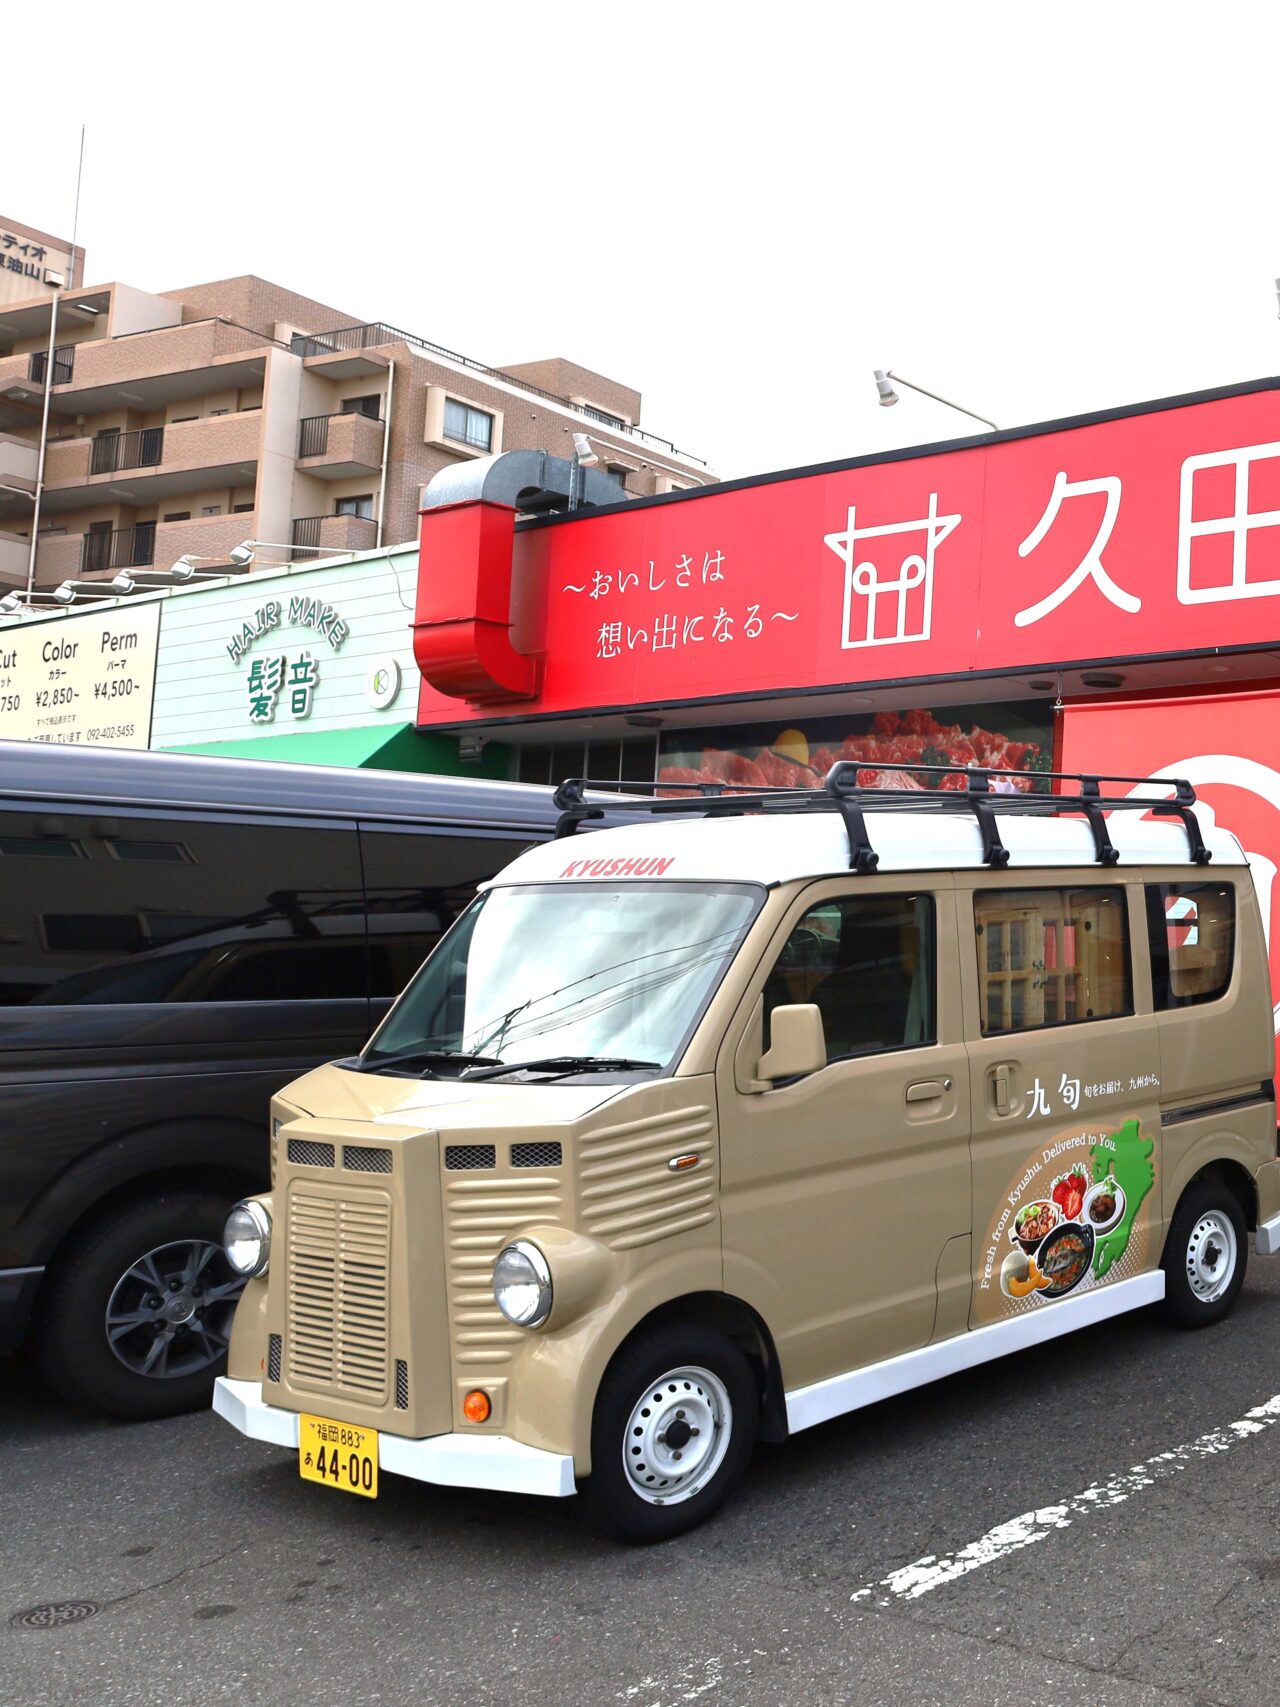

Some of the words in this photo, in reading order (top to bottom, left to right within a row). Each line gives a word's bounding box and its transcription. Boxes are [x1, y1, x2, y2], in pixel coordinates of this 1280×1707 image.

[101, 631, 138, 653] Perm
[226, 601, 281, 662] HAIR
[288, 597, 346, 648] MAKE
[42, 637, 79, 663] Color
[48, 668, 67, 680] カラー
[87, 724, 135, 741] 092-402-5455
[559, 857, 676, 878] KYUSHUN
[980, 1245, 998, 1290] Fresh
[993, 1207, 1011, 1244] from
[1042, 1132, 1086, 1164] Delivered
[1088, 1132, 1097, 1146] to
[317, 1423, 339, 1443] 福岡
[340, 1428, 360, 1449] 883
[316, 1445, 373, 1491] 44-00
